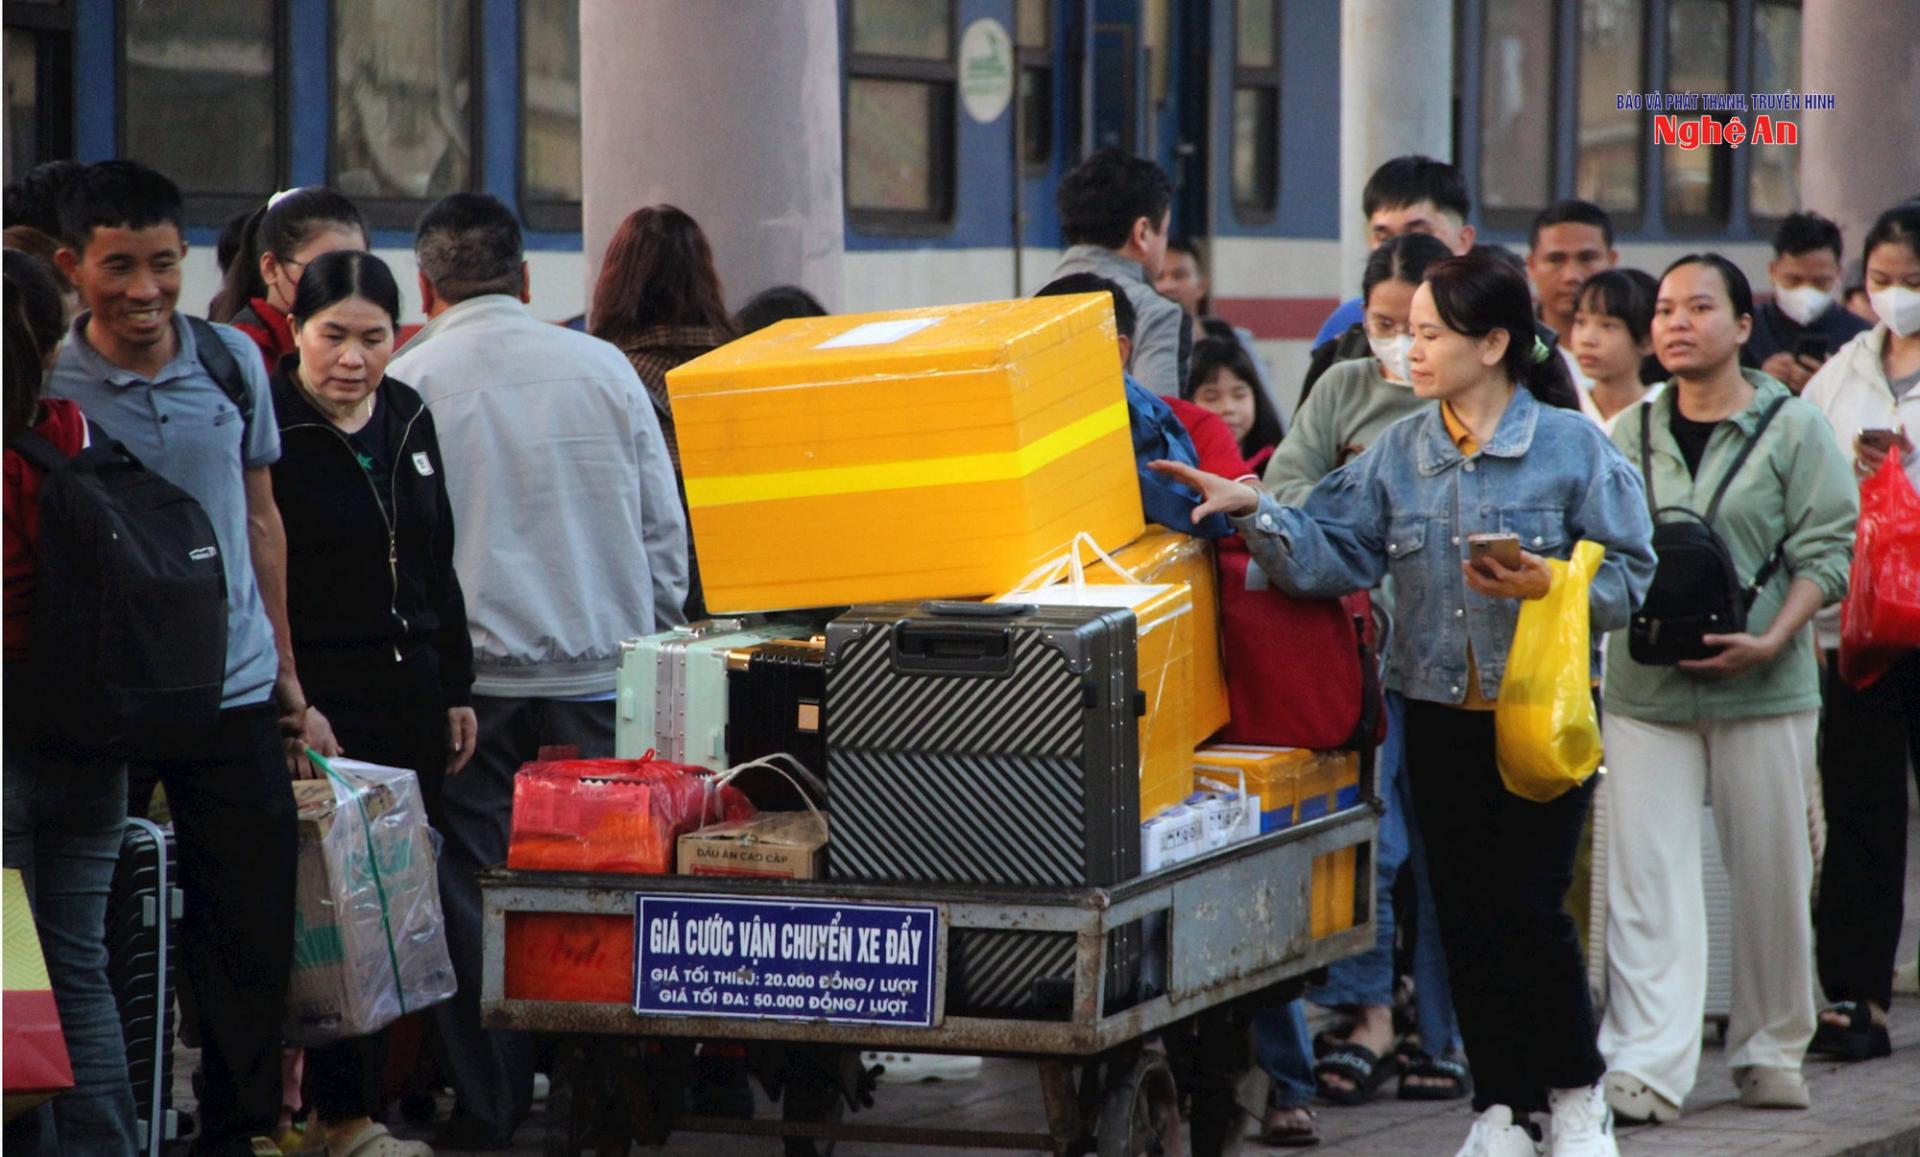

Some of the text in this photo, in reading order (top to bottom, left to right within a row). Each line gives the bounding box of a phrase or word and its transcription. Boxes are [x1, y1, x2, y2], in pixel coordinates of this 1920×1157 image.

[740, 851, 764, 862] CAO
[650, 911, 680, 954] GIÁ
[685, 913, 734, 957] CƯỚC
[739, 914, 777, 966] VẬN
[781, 911, 853, 962] CHUYỂN
[857, 927, 881, 963] XE
[885, 915, 922, 965] ĐẨY
[651, 966, 679, 982] GIÁ
[683, 965, 709, 983] TỐI
[764, 973, 815, 988] 20.000
[880, 978, 918, 997] LƯỢT
[659, 986, 688, 1003] GIÁ
[692, 986, 717, 1004] TỐI
[722, 992, 749, 1006] ĐA:
[753, 993, 805, 1008] 50.000
[869, 998, 908, 1017] LƯỢT
